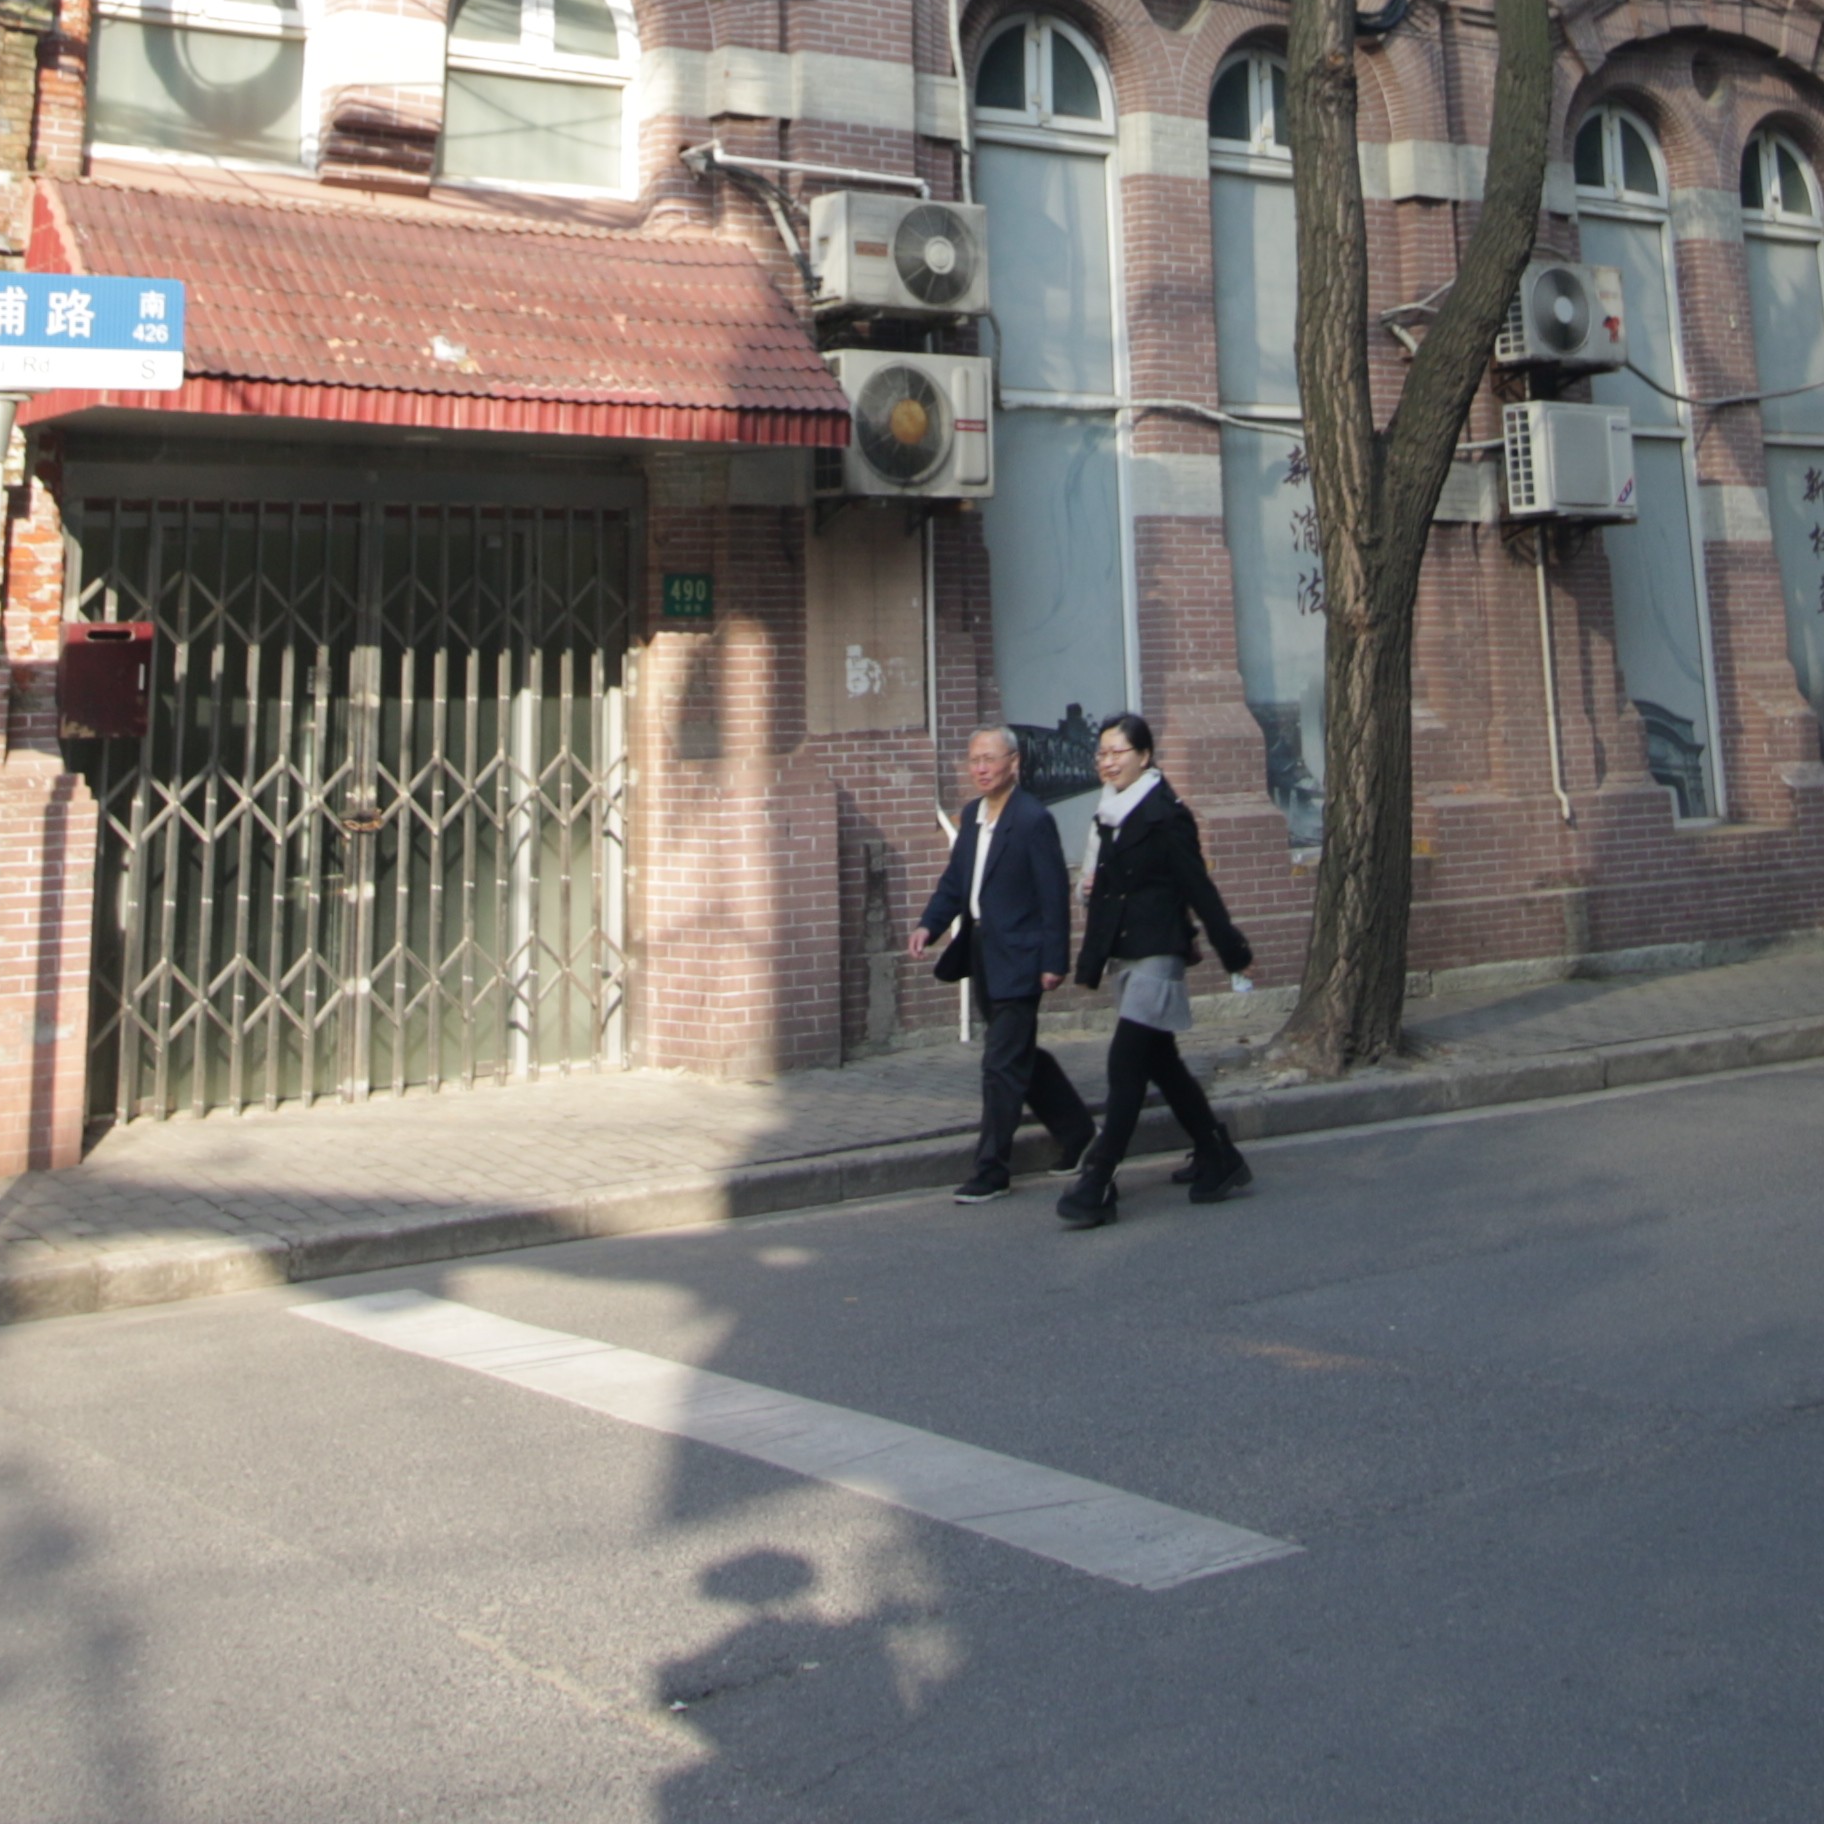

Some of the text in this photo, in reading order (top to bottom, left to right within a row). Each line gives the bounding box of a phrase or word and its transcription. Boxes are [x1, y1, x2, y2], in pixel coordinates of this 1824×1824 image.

[139, 290, 167, 319] 南
[132, 323, 168, 343] 426
[23, 356, 50, 373] Rd
[141, 359, 156, 379] S
[670, 579, 706, 602] 490
